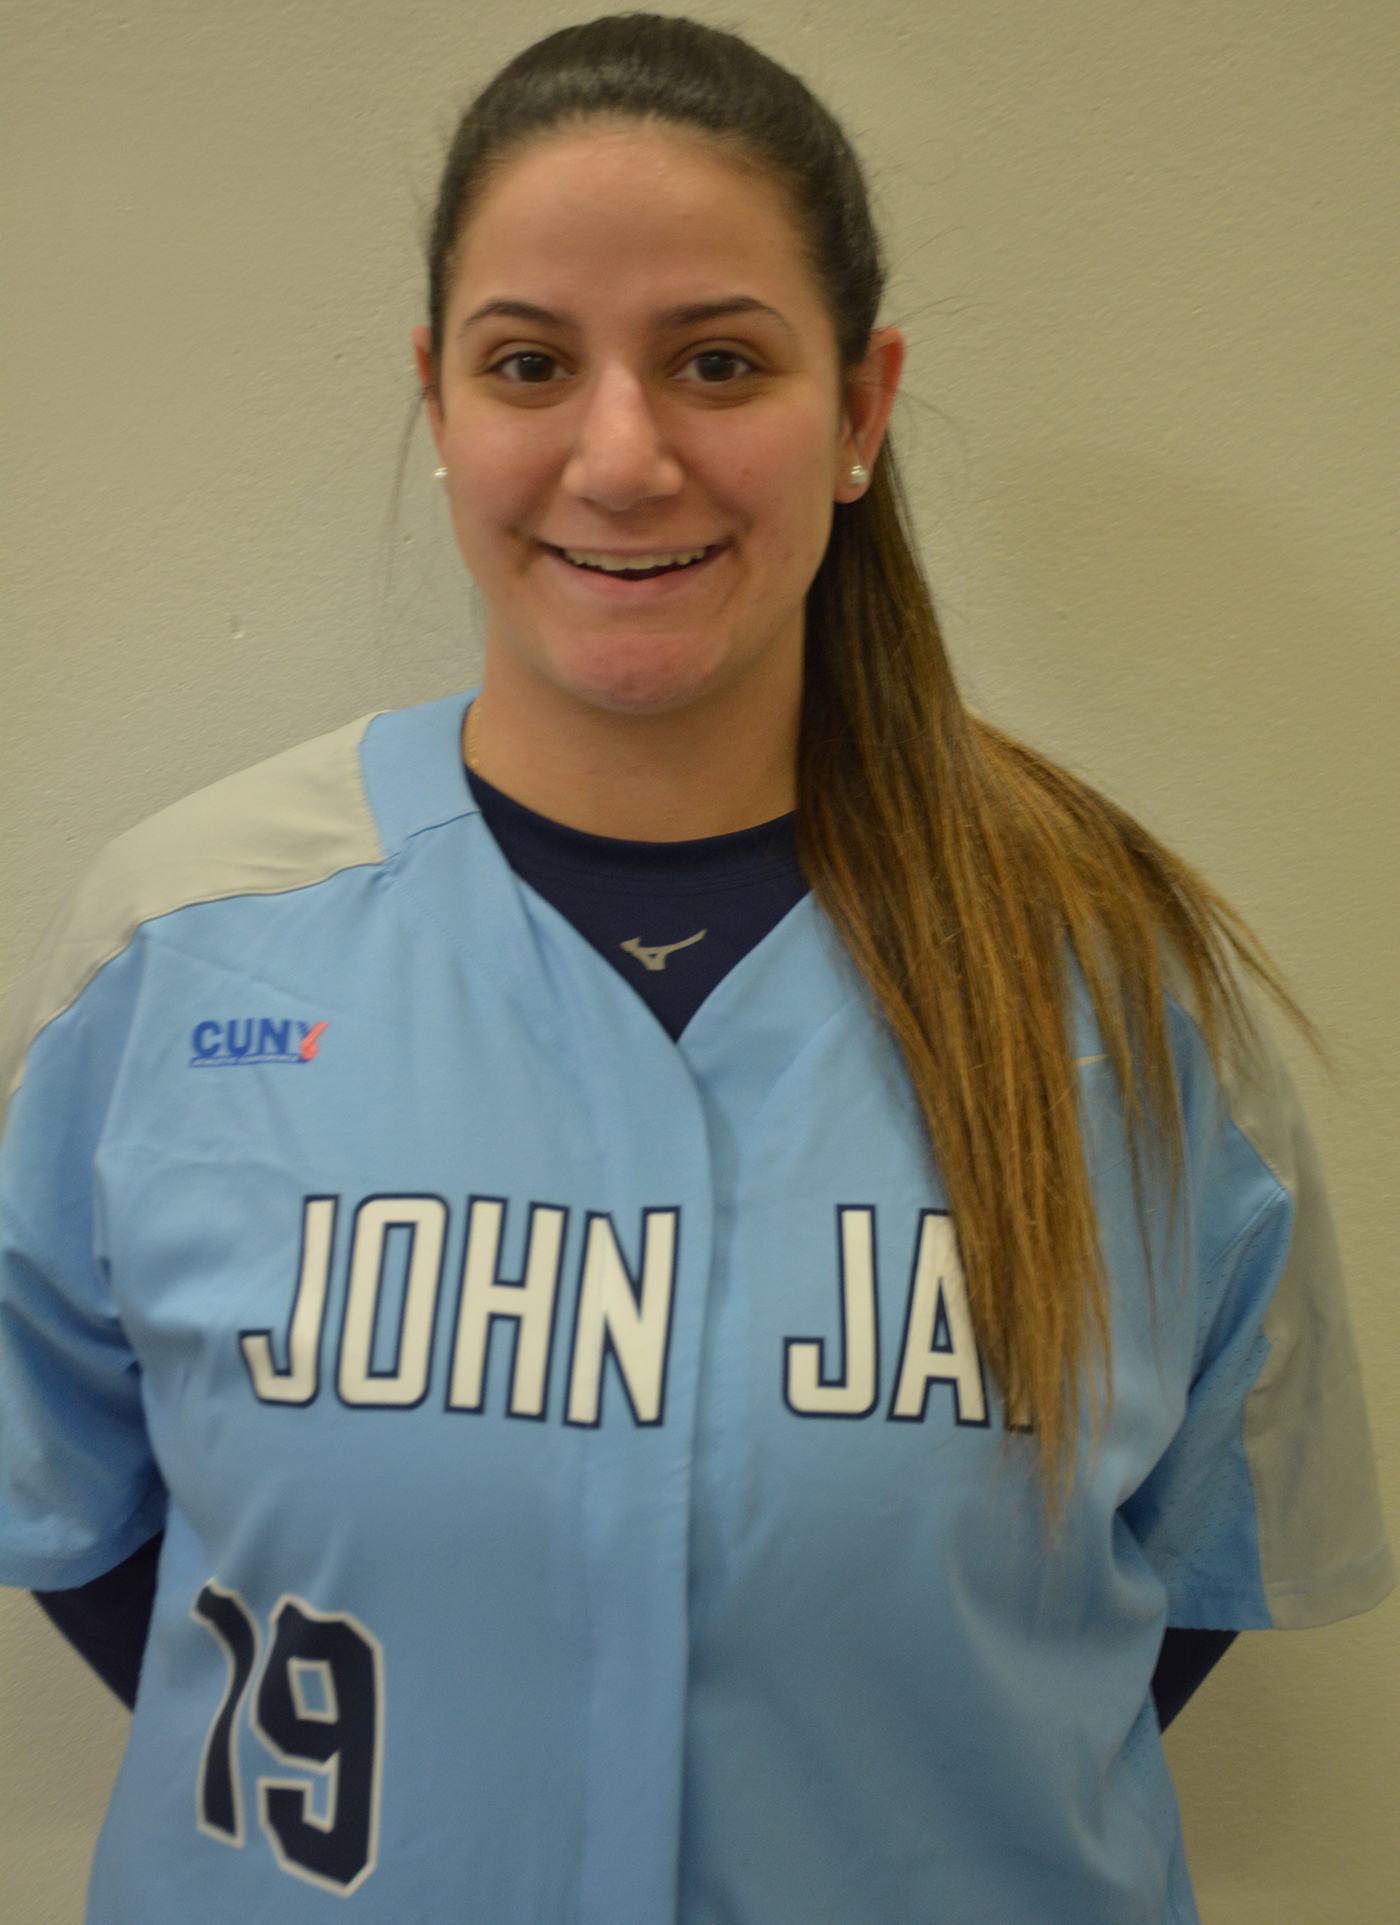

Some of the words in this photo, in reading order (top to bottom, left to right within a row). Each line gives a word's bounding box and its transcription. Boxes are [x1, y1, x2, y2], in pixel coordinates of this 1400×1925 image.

[192, 1018, 329, 1060] CUNY
[238, 1193, 681, 1429] JOHN
[783, 1204, 1034, 1433] JA
[190, 1576, 384, 1897] 19
